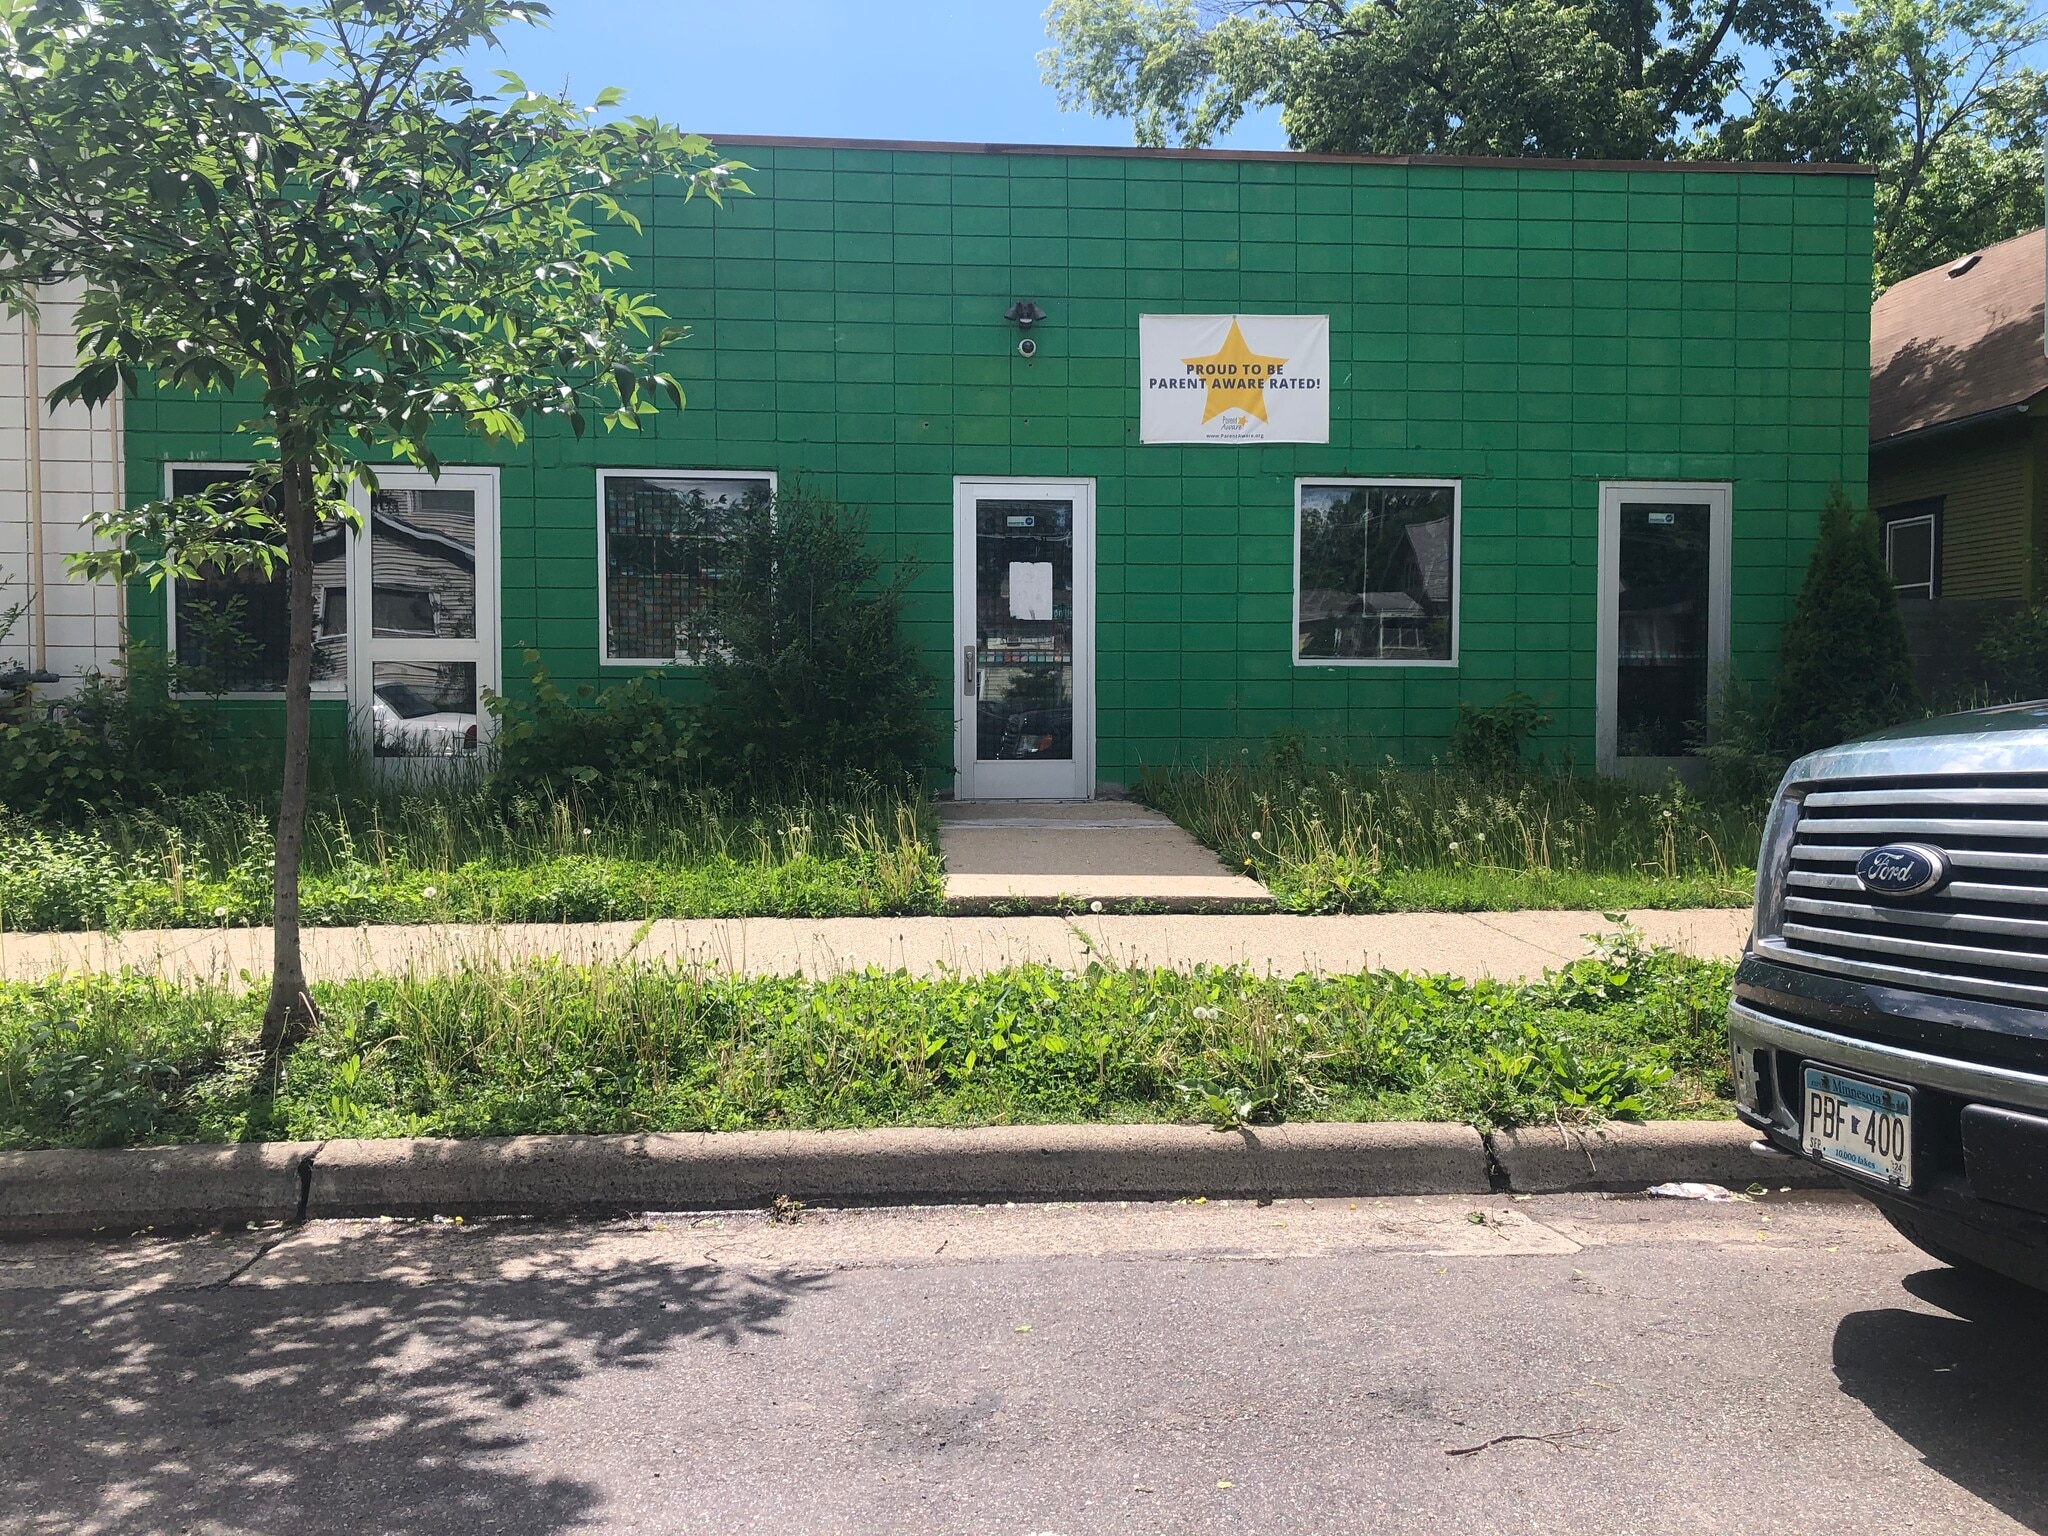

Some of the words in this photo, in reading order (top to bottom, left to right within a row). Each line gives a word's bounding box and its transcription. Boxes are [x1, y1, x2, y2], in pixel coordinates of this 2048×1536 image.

[1186, 364, 1237, 375] PROUD
[1242, 364, 1262, 375] TO
[1267, 364, 1284, 375] BE
[1149, 378, 1207, 389] PARENT
[1212, 378, 1265, 389] AWARE
[1270, 378, 1321, 389] RATED!
[1222, 415, 1237, 424] Parent
[1867, 852, 1915, 882] Ford
[1832, 1078, 1881, 1104] Minnesota
[1810, 1092, 1848, 1141] PBF
[1864, 1110, 1905, 1162] 400
[1835, 1149, 1857, 1163] 10,000
[1858, 1156, 1876, 1170] lakes
